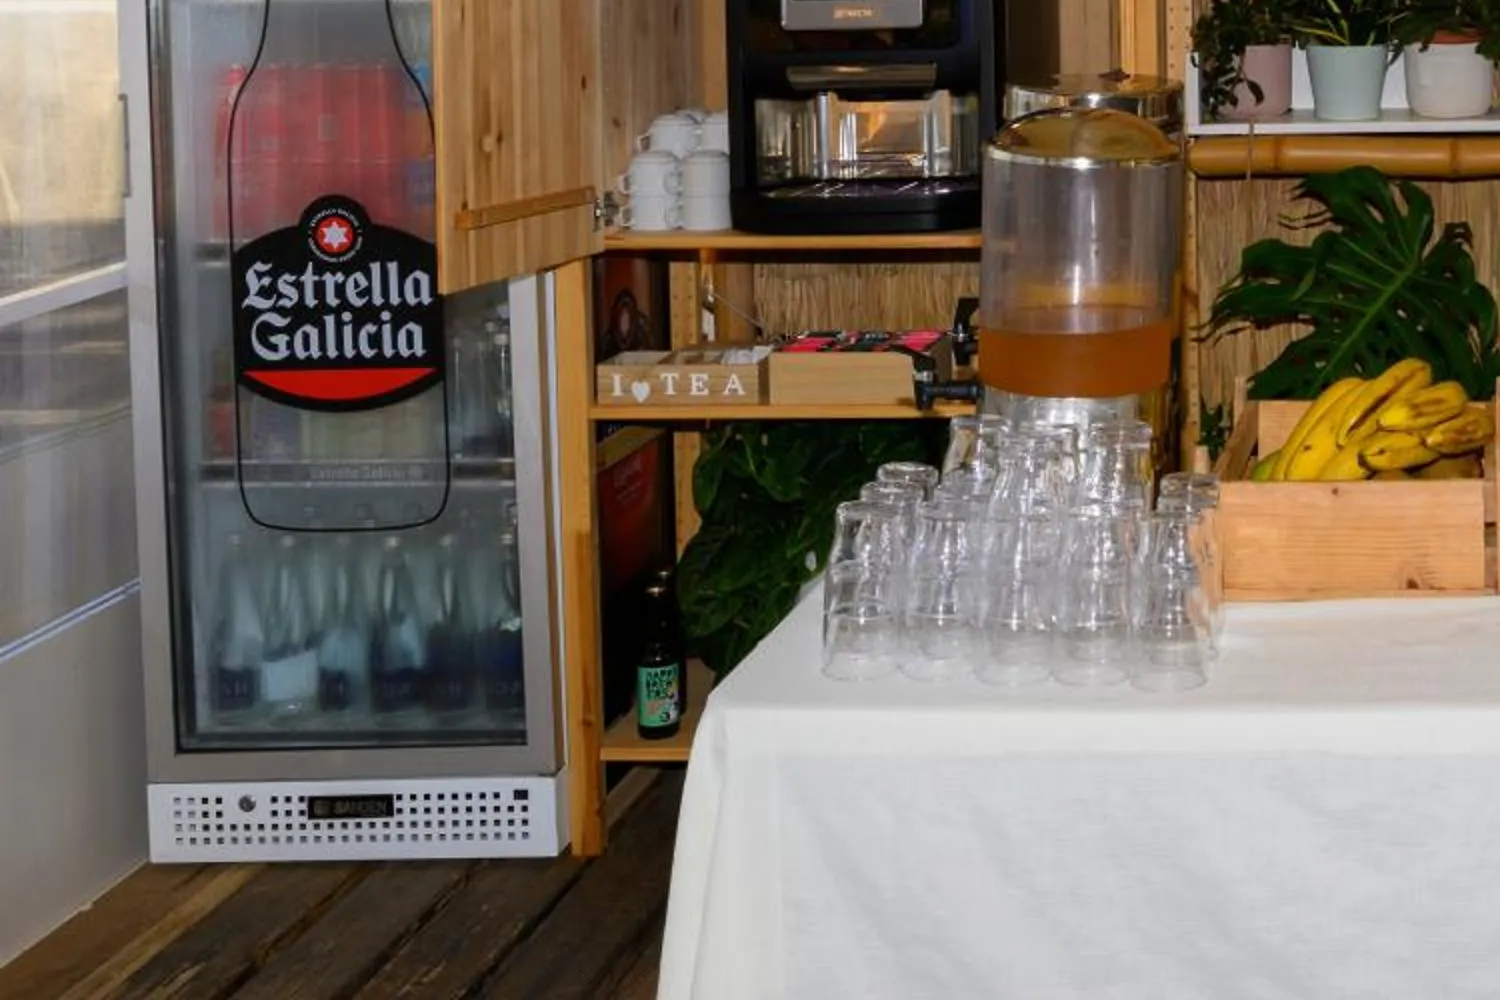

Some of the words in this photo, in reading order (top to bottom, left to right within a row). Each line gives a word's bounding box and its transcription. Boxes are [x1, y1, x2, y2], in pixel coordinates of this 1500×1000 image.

[242, 261, 435, 309] Estrella
[251, 310, 427, 360] Galicia
[612, 373, 623, 396] I
[659, 372, 746, 395] TEA
